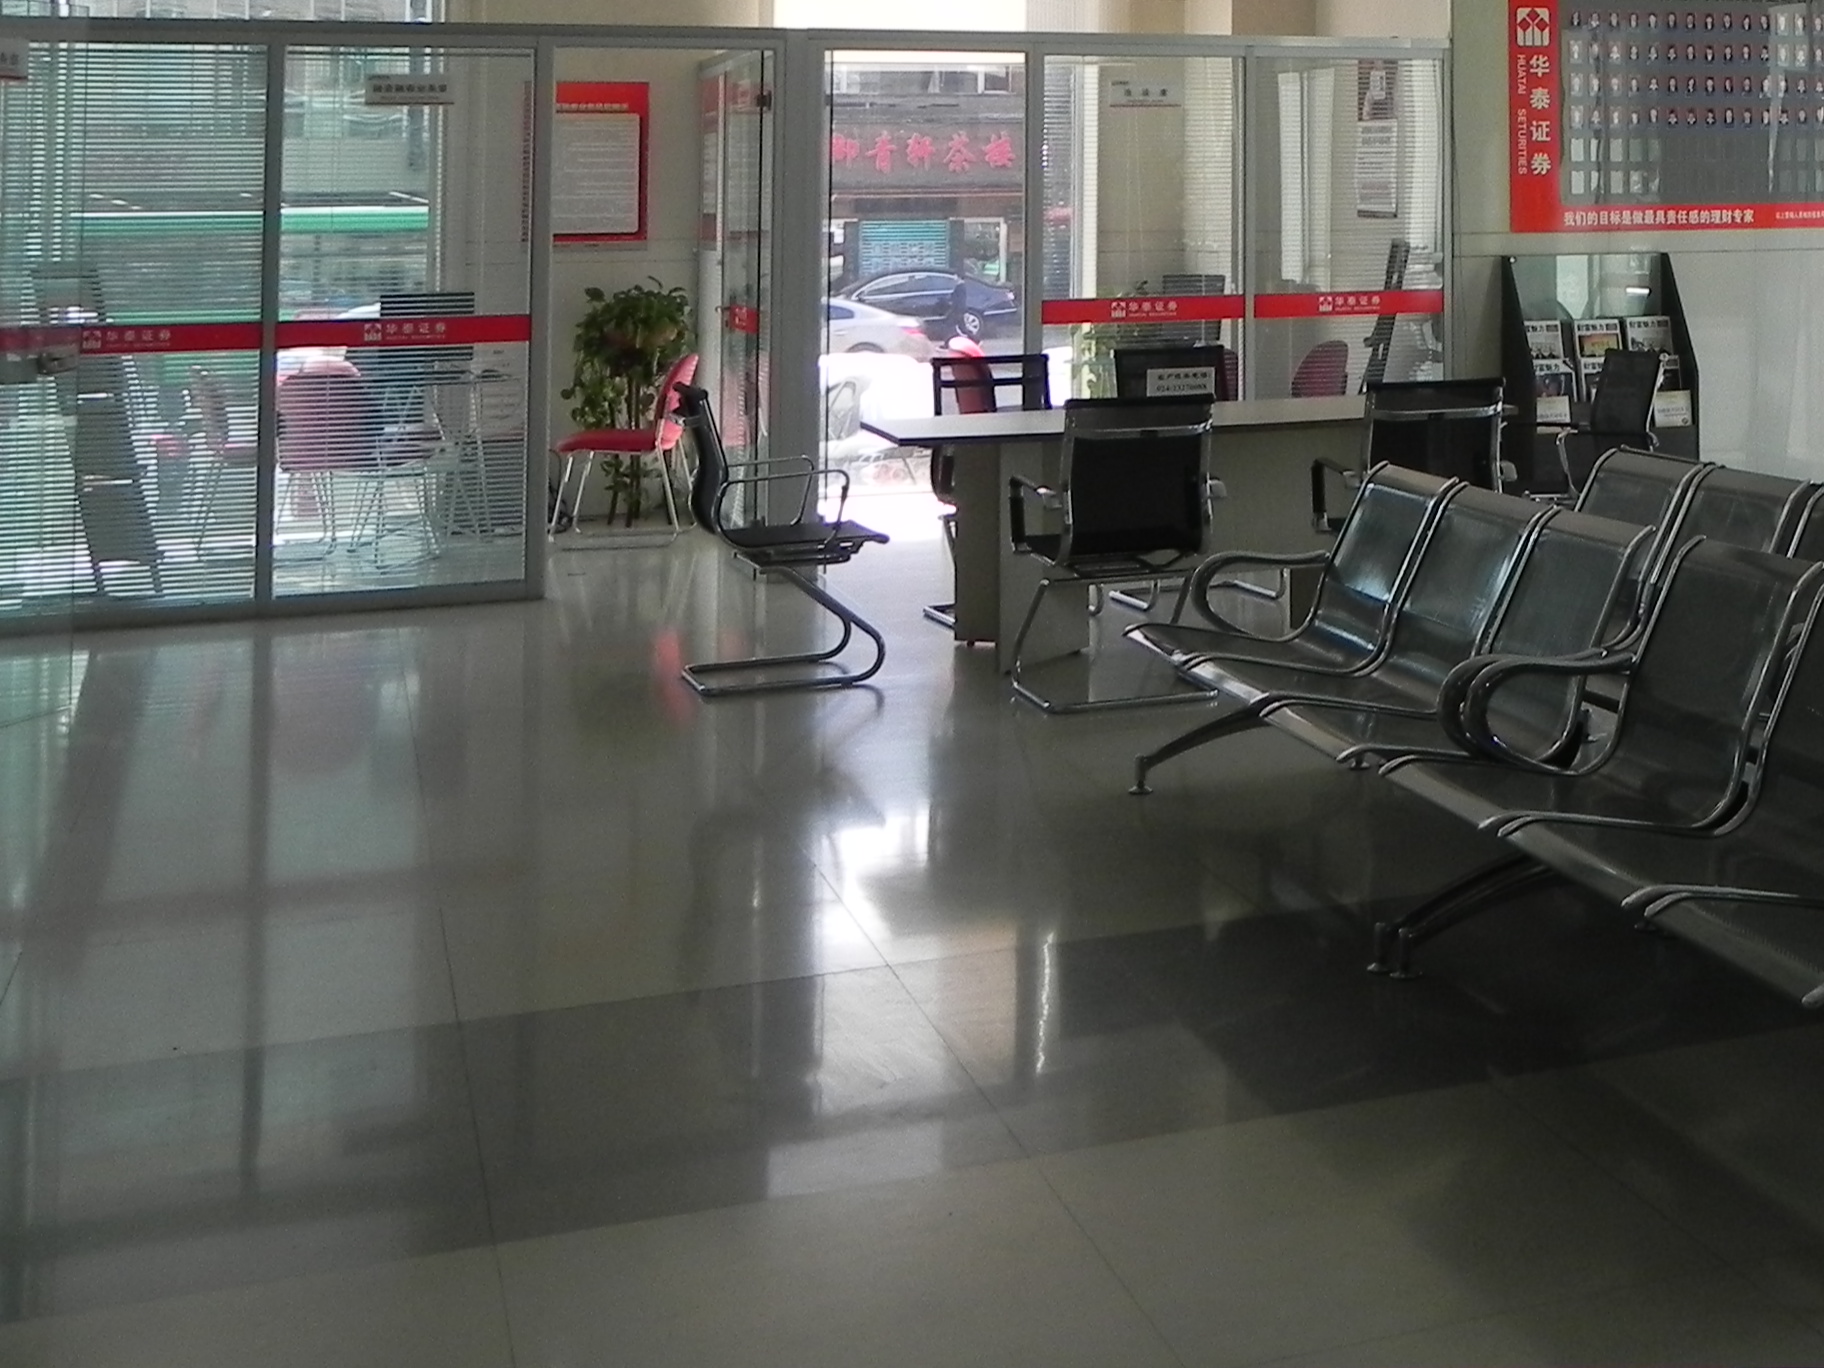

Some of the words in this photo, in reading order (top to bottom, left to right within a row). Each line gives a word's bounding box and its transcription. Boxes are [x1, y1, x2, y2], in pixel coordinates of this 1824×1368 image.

[1516, 54, 1527, 95] HUATAI
[1529, 54, 1552, 176] 华泰证券
[1563, 209, 1755, 227] 我们的目标是做最具责任感的理财专家
